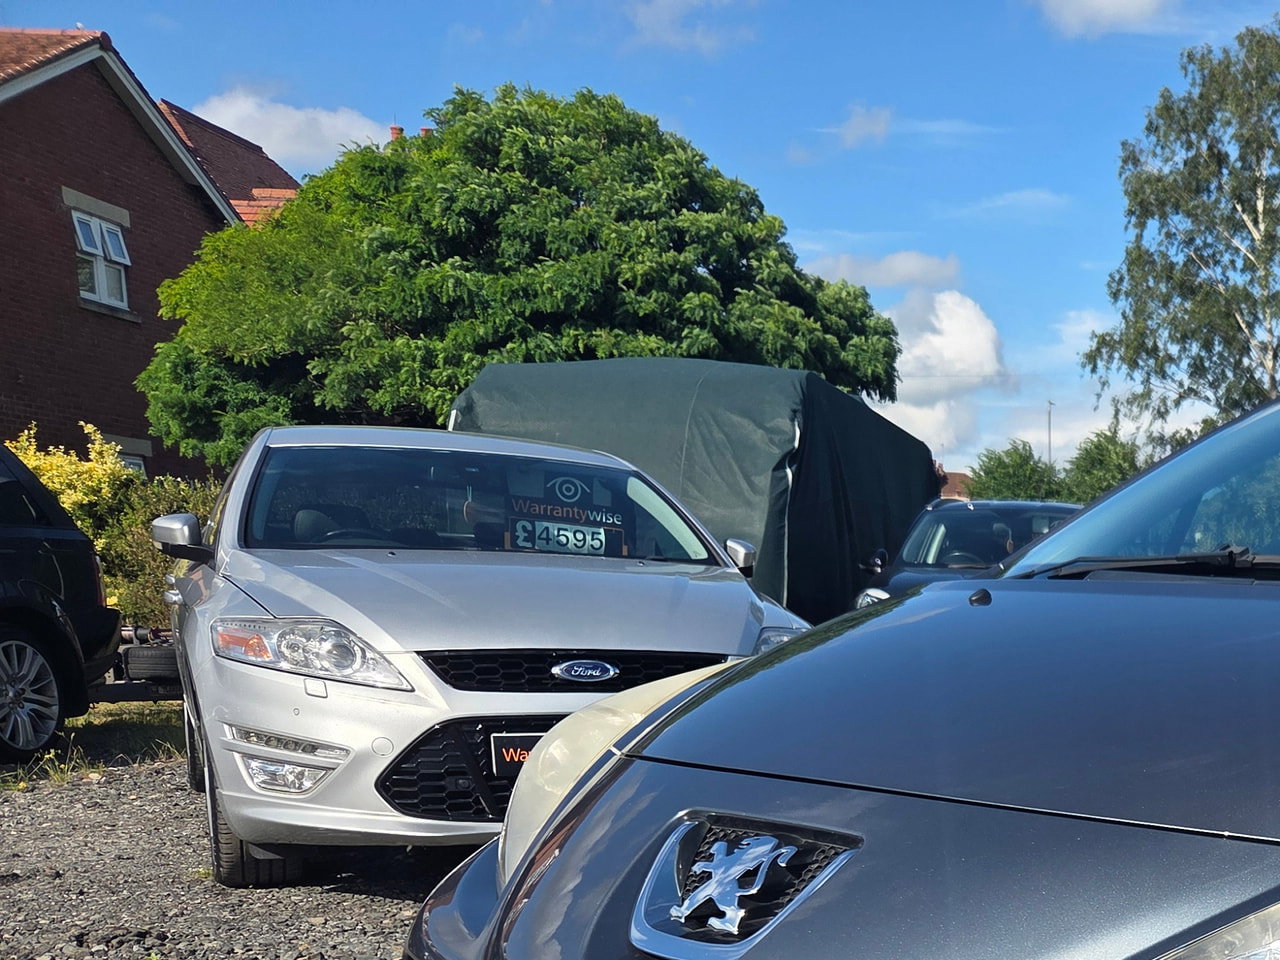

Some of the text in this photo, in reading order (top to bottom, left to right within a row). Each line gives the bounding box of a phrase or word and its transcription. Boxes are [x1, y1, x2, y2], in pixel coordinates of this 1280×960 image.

[511, 498, 623, 525] Warrantywise
[515, 520, 604, 550] £4595
[571, 664, 602, 677] Ford
